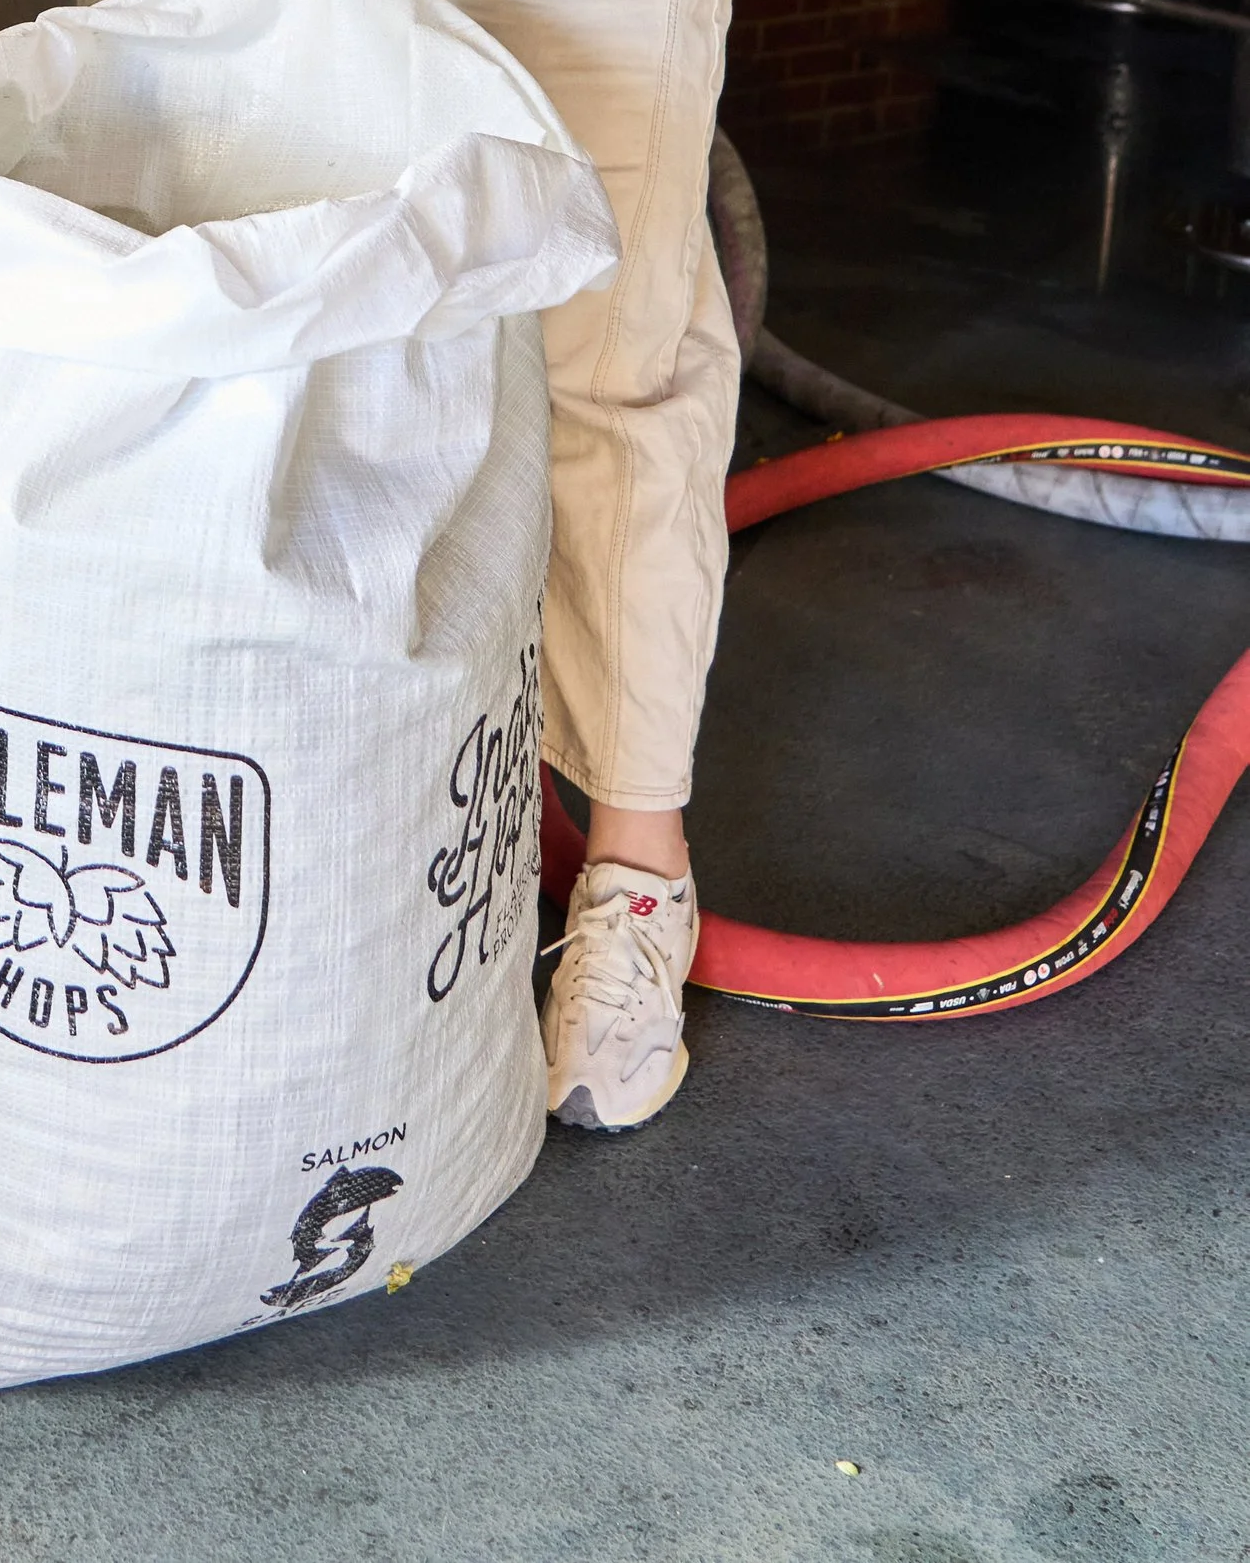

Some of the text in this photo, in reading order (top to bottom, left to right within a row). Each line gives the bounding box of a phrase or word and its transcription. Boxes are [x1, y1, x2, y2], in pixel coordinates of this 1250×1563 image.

[999, 980, 1017, 995] FDA
[939, 996, 966, 1009] USDA
[301, 1122, 407, 1172] SALMON
